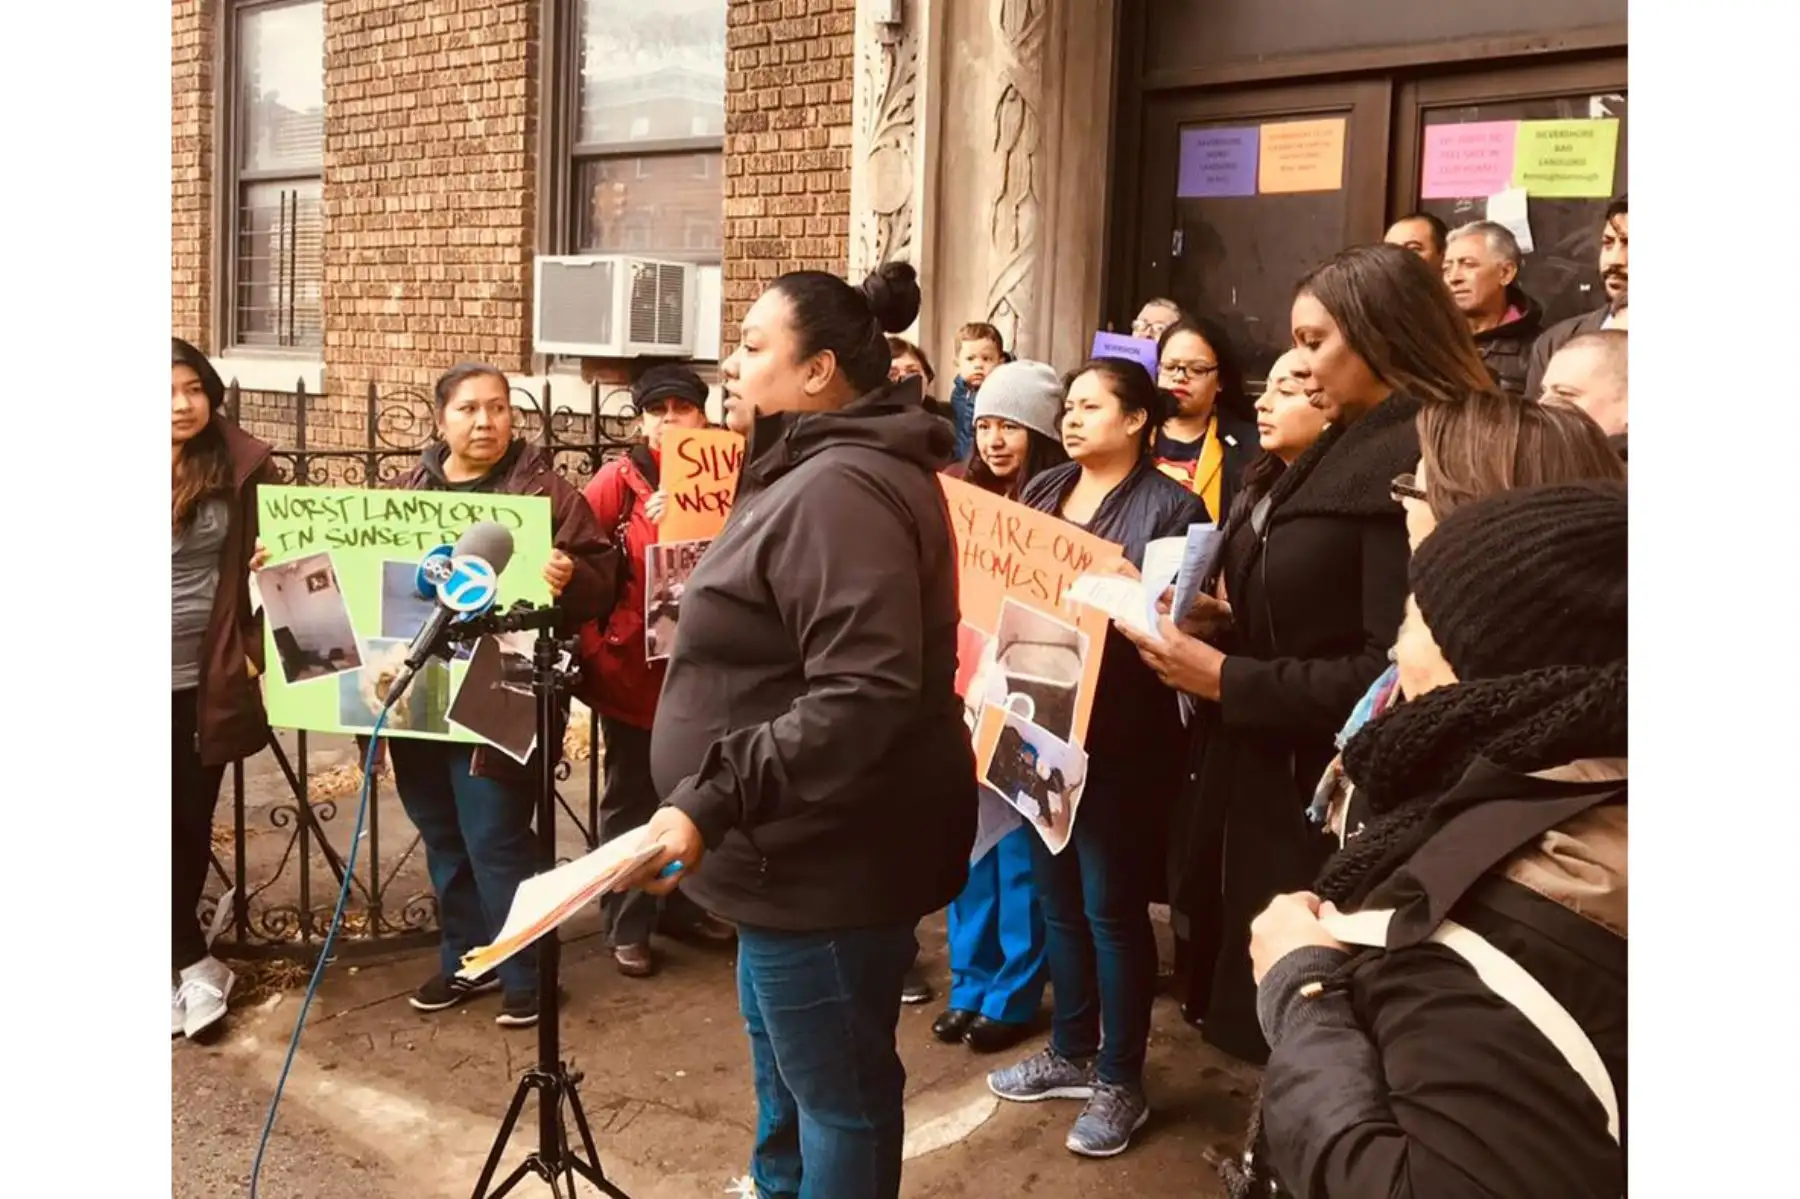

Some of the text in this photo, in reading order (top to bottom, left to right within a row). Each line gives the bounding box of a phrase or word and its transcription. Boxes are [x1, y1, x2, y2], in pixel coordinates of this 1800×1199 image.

[265, 494, 523, 530] WORST LANDLORD
[277, 525, 314, 553] IN
[324, 525, 432, 551] SUNSET
[989, 509, 1049, 557] ARE
